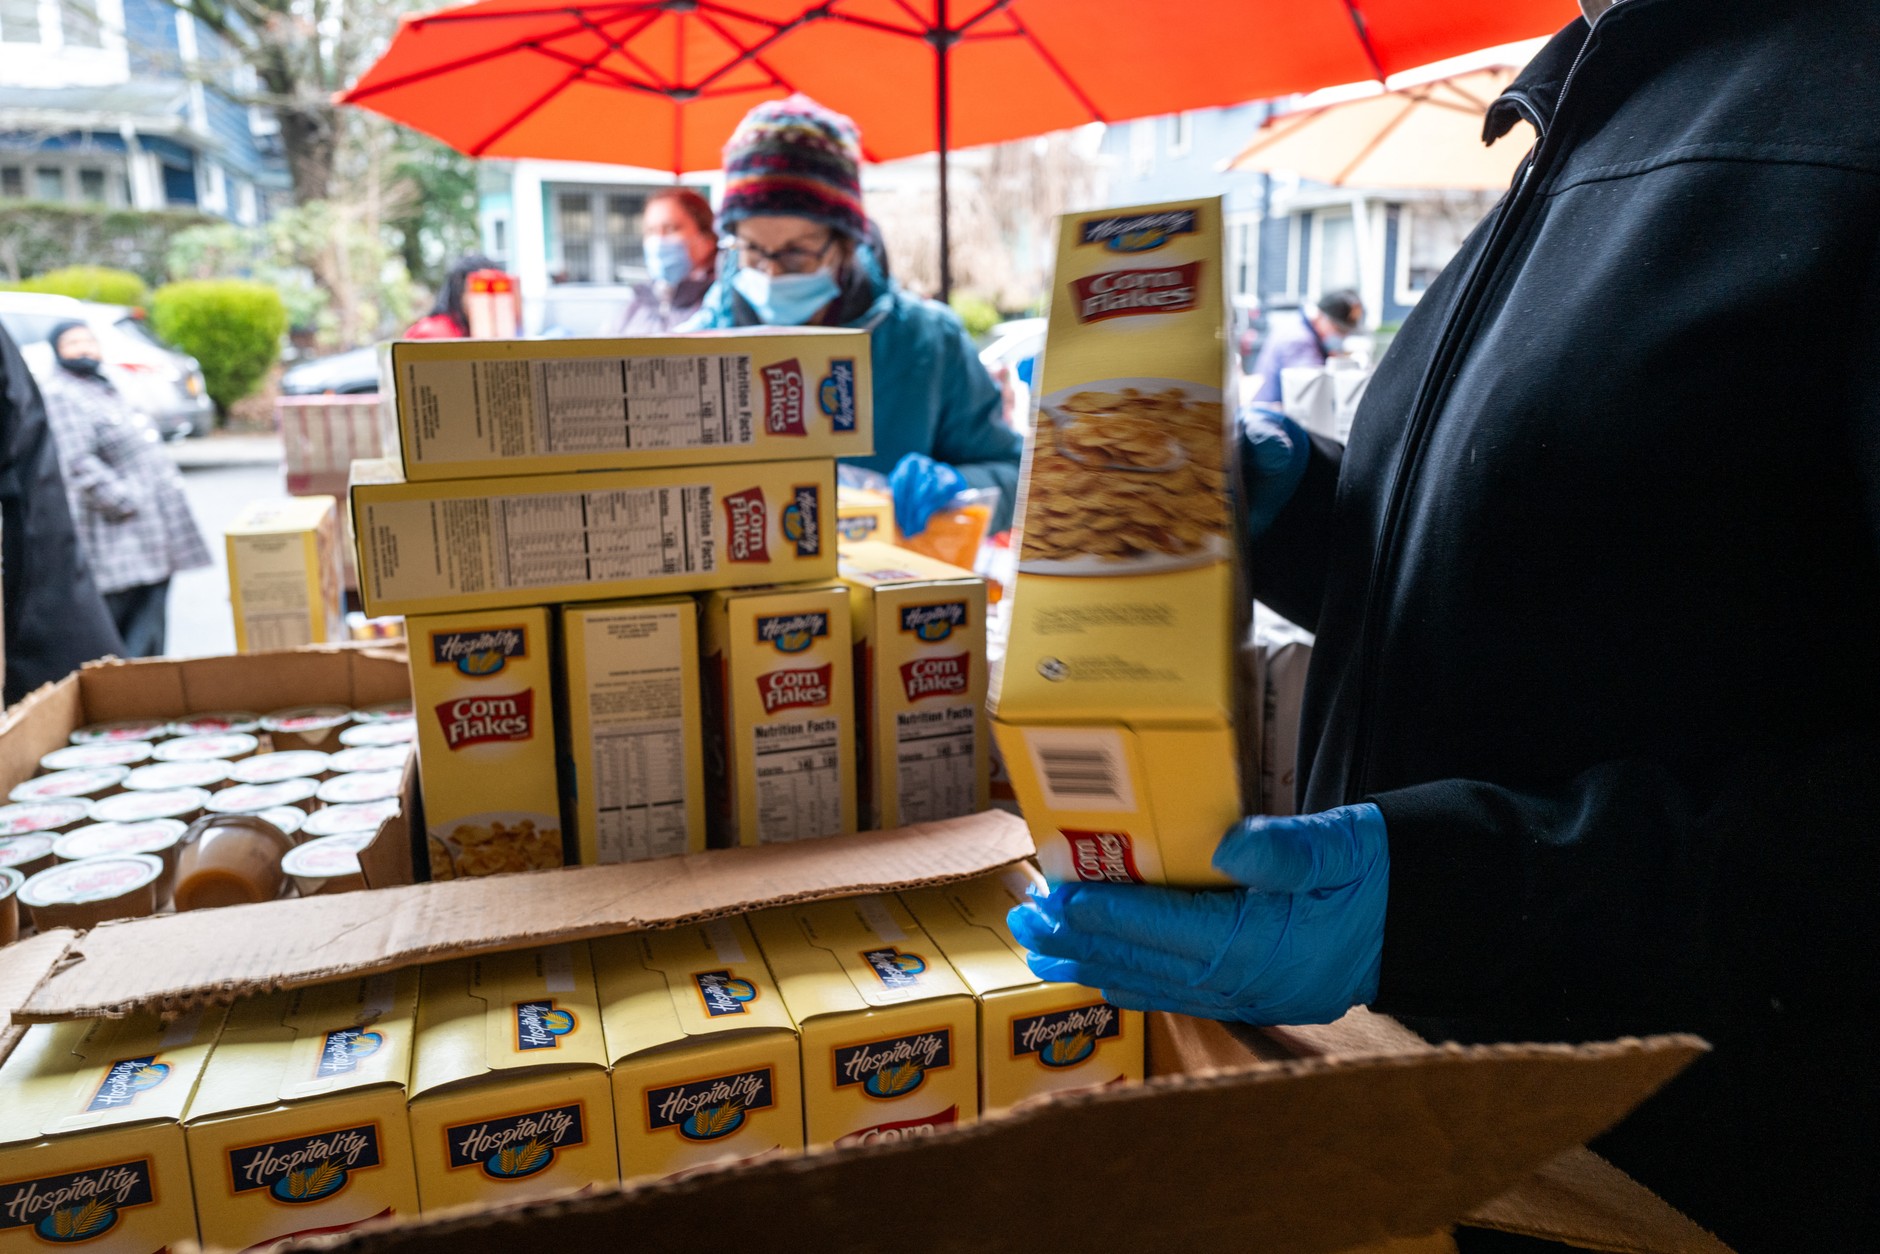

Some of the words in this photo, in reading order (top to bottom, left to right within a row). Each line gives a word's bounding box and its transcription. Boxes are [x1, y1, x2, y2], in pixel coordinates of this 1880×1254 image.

[1089, 270, 1183, 294] Corn
[1081, 286, 1193, 318] Flakes
[737, 357, 749, 407] Nutrition
[766, 368, 787, 431] Flakes
[785, 372, 802, 423] Corn
[739, 412, 752, 442] Facts
[699, 486, 712, 537] Nutrition
[729, 496, 750, 559] Flakes
[749, 499, 765, 551] Corn
[702, 540, 714, 571] Facts
[761, 615, 824, 637] Hospitality
[904, 604, 962, 627] Hospitality
[441, 630, 519, 660] Hospitality
[769, 671, 819, 689] Corn
[908, 673, 964, 698] Flakes
[911, 659, 958, 677] Corn
[452, 697, 517, 721] Corn
[766, 684, 827, 709] Flakes
[898, 711, 943, 726] Nutrition
[947, 706, 973, 720] Facts
[449, 715, 527, 744] Flakes
[755, 724, 803, 739] Nutrition
[808, 719, 836, 732] Facts
[1075, 839, 1105, 880] Corn
[1096, 833, 1133, 883] Flakes
[868, 952, 914, 984] Hospitality
[700, 974, 737, 1012] Hospitality
[520, 1002, 548, 1046] Hospitality
[1022, 1005, 1113, 1049] Hospitality
[322, 1031, 359, 1071] Hospitality
[844, 1035, 943, 1081] Hospitality
[97, 1061, 148, 1104] Hospitality
[658, 1073, 764, 1123] Hospitality
[459, 1111, 574, 1161] Hospitality
[243, 1130, 368, 1185] Hospitality
[7, 1167, 141, 1222] Hospitality
